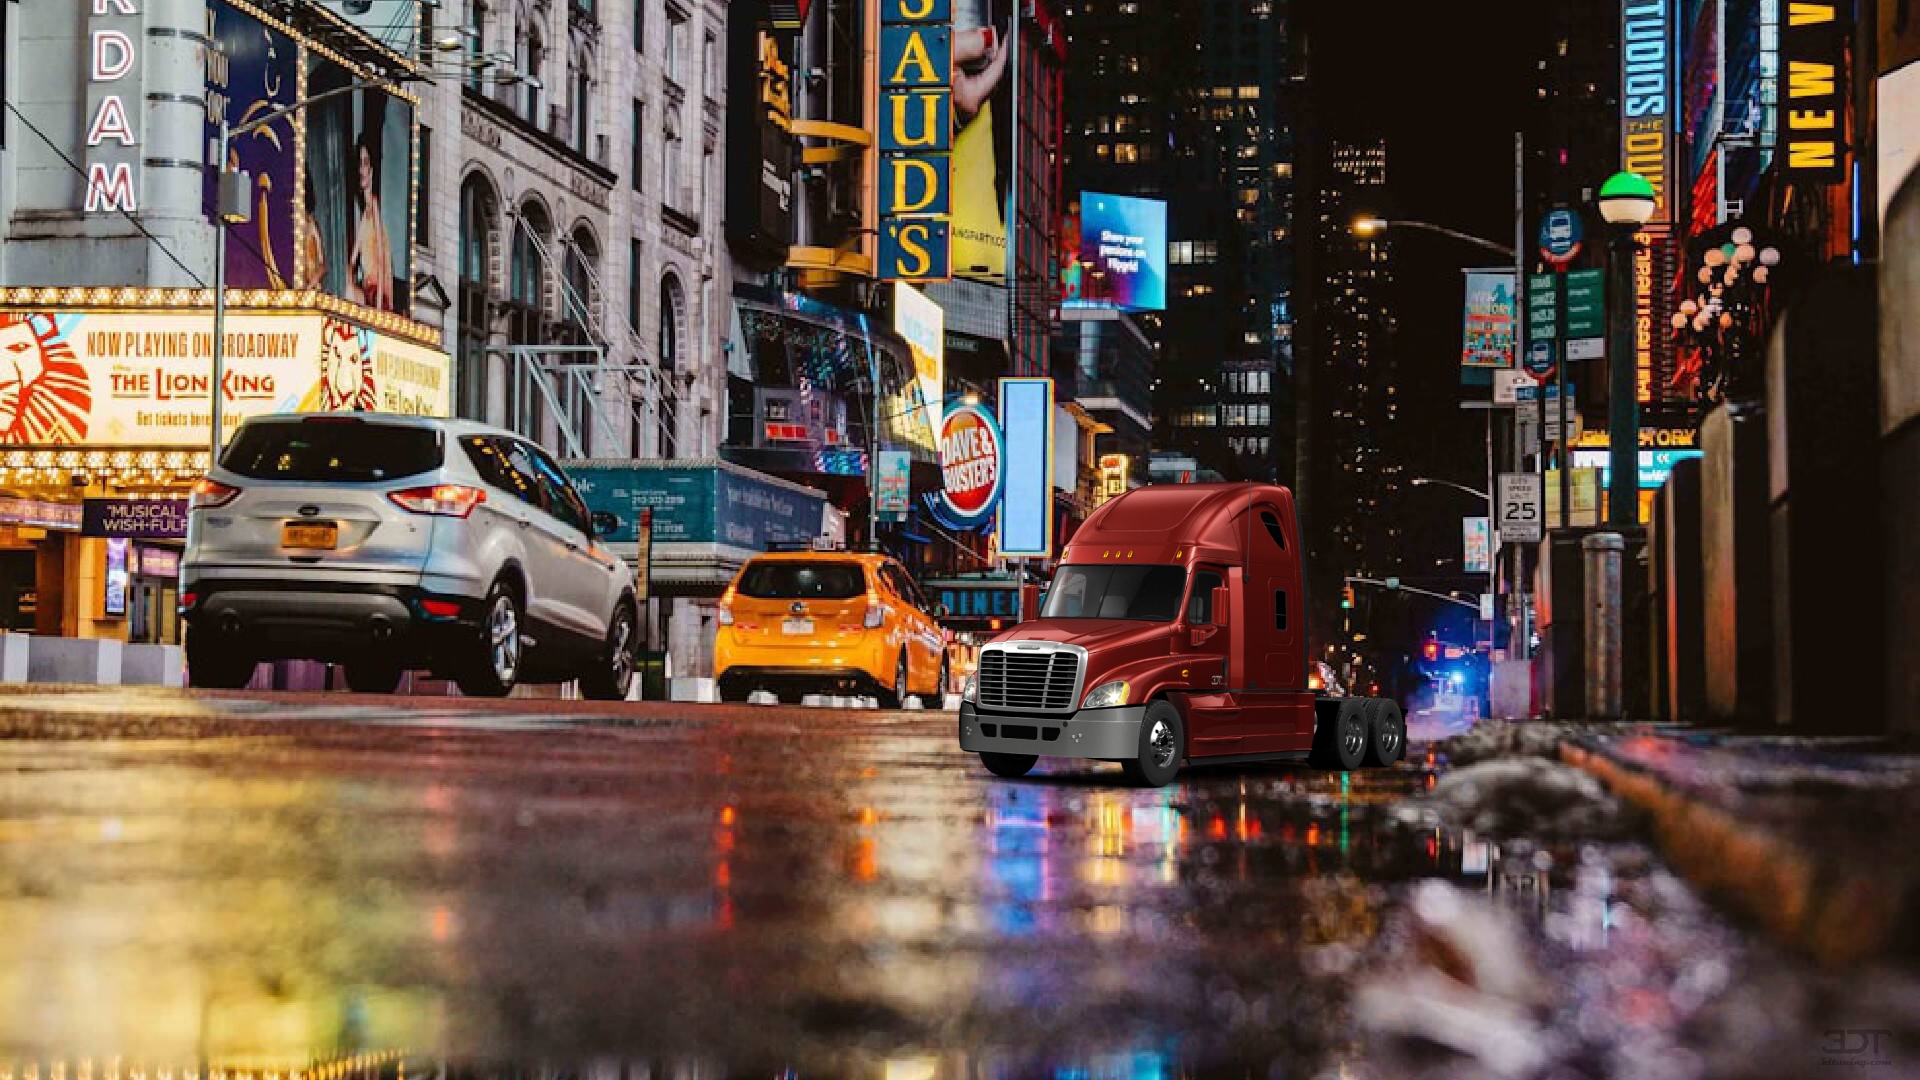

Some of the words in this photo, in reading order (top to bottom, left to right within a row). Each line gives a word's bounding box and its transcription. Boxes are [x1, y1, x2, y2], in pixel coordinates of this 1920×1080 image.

[85, 0, 137, 212] DAM
[1789, 61, 1835, 168] NEW
[88, 332, 121, 358] NOW
[126, 332, 188, 358] PLAYING
[192, 332, 211, 358] ON
[222, 333, 299, 359] ROADWAY
[110, 374, 150, 391] THE
[156, 368, 209, 400] LION
[942, 427, 981, 468] DAVE
[1506, 502, 1536, 520] 25
